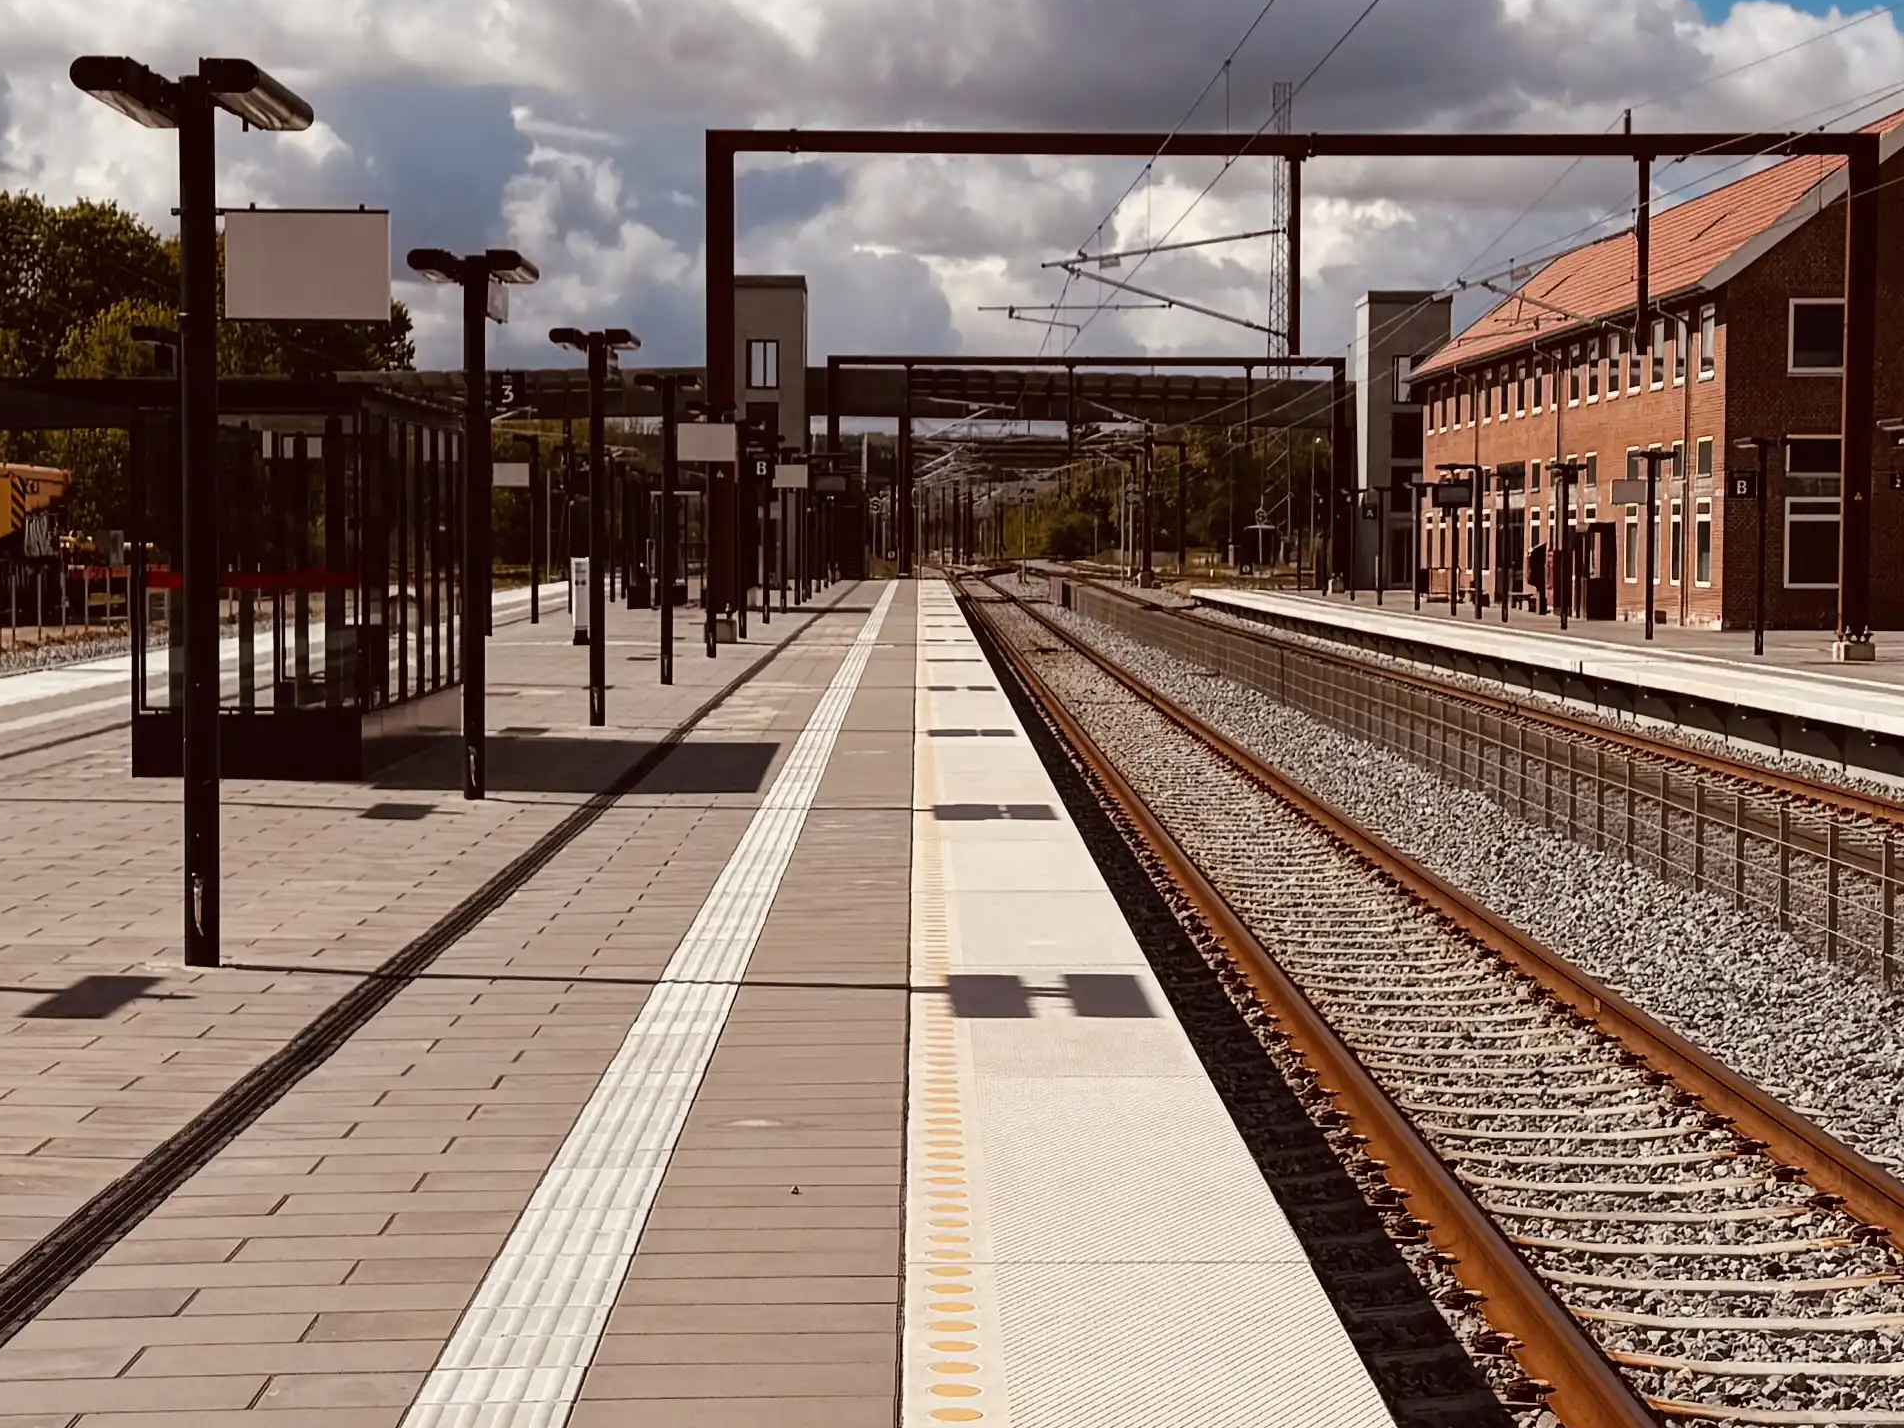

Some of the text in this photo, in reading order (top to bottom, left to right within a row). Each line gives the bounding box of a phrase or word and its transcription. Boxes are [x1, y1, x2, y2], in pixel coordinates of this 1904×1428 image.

[501, 384, 515, 404] 3
[756, 460, 767, 476] B
[1736, 480, 1748, 495] B
[1366, 508, 1374, 518] A
